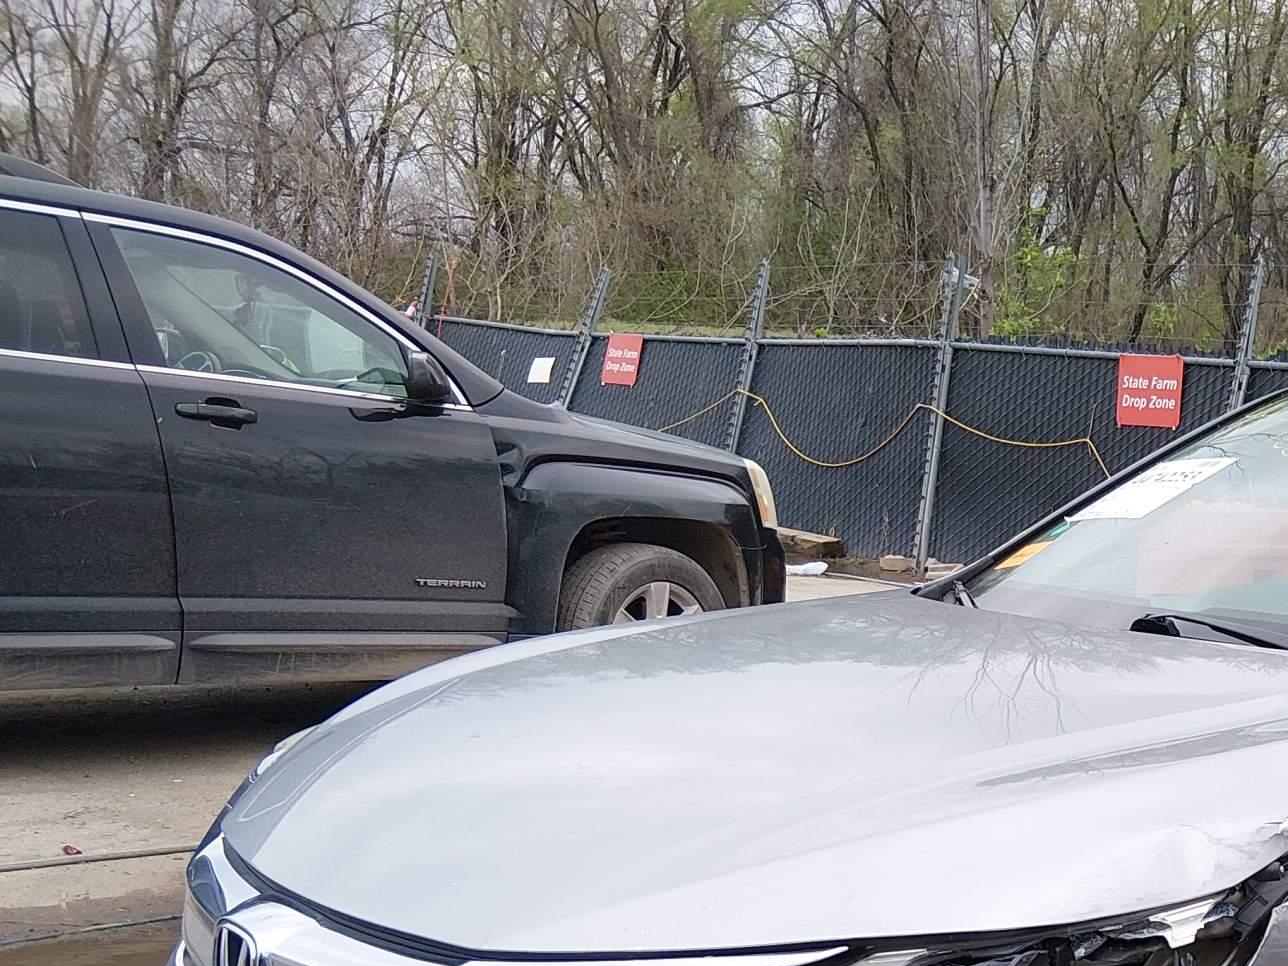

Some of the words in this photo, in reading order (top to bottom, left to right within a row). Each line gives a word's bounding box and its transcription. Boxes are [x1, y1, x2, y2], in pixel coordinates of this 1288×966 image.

[608, 348, 622, 358] State
[623, 349, 638, 358] Farm
[606, 361, 620, 373] Drop
[620, 362, 635, 372] Zone
[1122, 376, 1148, 389] State
[1151, 377, 1178, 390] Farm
[1122, 395, 1147, 410] Drop
[1149, 396, 1175, 409] Zone
[415, 578, 487, 589] TERRAIN
